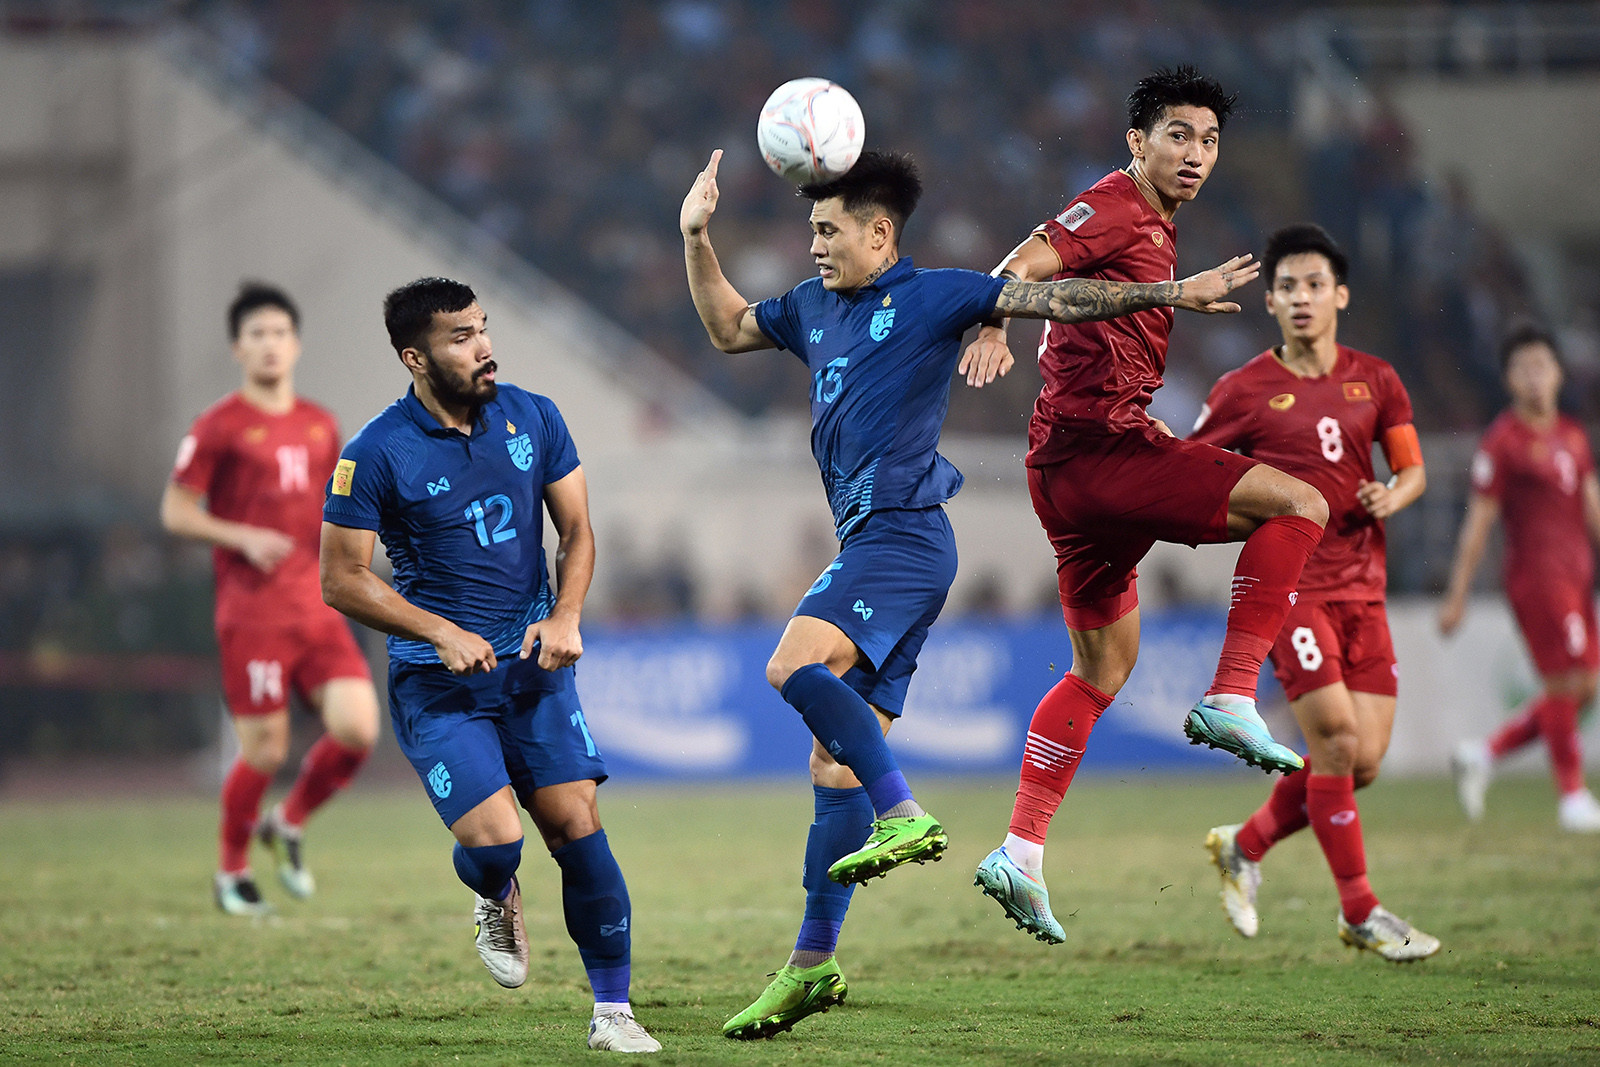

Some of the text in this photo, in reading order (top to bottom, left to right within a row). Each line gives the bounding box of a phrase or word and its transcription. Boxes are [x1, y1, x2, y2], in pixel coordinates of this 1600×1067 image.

[815, 357, 849, 404] 15
[1316, 416, 1345, 463] 8
[463, 493, 517, 548] 12
[1291, 626, 1323, 672] 8
[569, 709, 602, 758] 1
